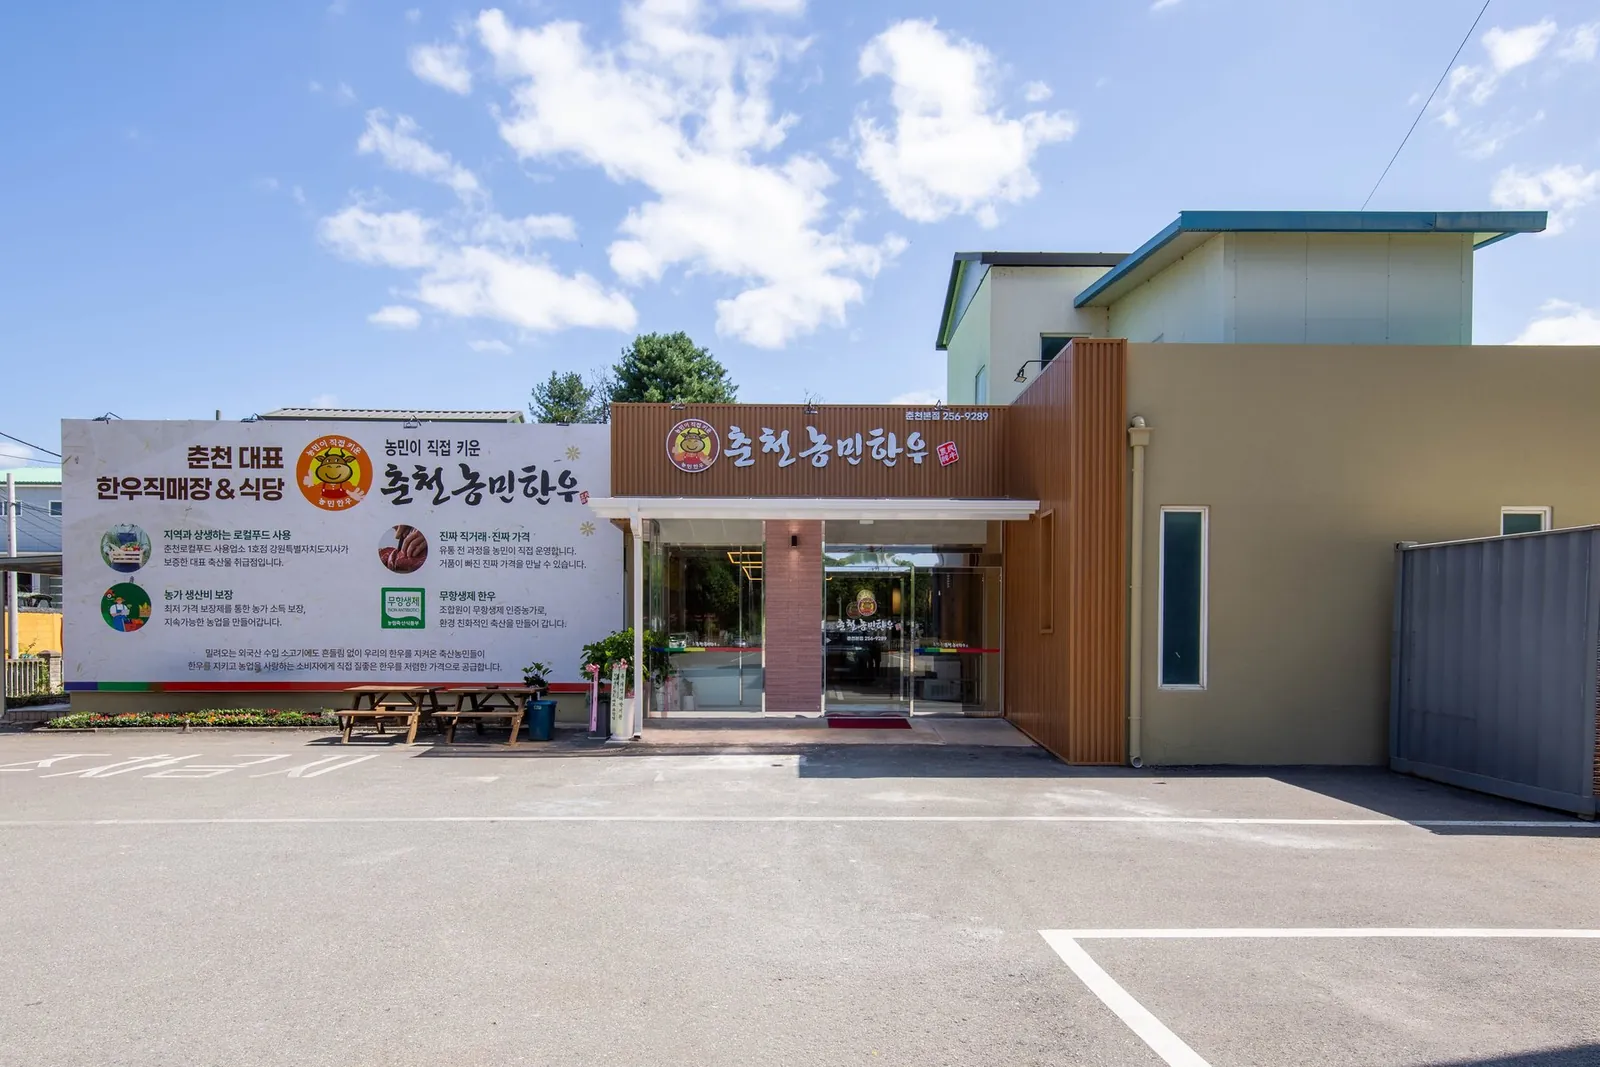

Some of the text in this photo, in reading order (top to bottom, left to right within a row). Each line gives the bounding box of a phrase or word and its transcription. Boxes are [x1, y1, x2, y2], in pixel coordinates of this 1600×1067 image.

[905, 411, 989, 421] 춘천본점 256-9289
[306, 438, 362, 457] 농민이 직접 키운
[384, 439, 481, 457] 농민이 직접 키운
[187, 445, 284, 470] 춘천 대표
[96, 476, 285, 501] 한우직매장 & 식당
[163, 529, 292, 541] 지역과 상생하는 로컬푸드 사용
[439, 531, 458, 542] 진짜
[512, 531, 530, 543] 가격
[163, 543, 349, 554] 춘천로컬푸드 사용업소 1호점 강원특별자치도지사가
[439, 545, 577, 557] 유통 전 과정을 농민이 직접 운영합니다.
[164, 557, 284, 568] 보증한 대표 축산물 취급점입니다.
[439, 559, 587, 570] 거품이 빠진 진짜 가격을 만날 수 있습니다.
[164, 589, 234, 601] 농가 생산비 보장
[439, 590, 496, 602] 무항생제 한우
[387, 596, 420, 607] 무항생제
[164, 604, 306, 615] 최저 가격 보장제를 통한 농가 소득 보장,
[439, 605, 547, 617] 조합원이 무항생제 인증농가로,
[164, 617, 282, 628] 지속가능한 농업을 만들어갑니다.
[439, 618, 567, 629] 환경 친화적인 축산을 만들어 갑니다.
[205, 648, 485, 659] 밀려오는 외국산 수입 소고기에도 흔들림 없이 우리의 한우를 지켜온 축산농민들이
[187, 661, 503, 672] 한우를 지키고 농업을 사랑하는 소비자에게 직접 질좋은 한우를 저렴한 가격으로 공급합니다.
